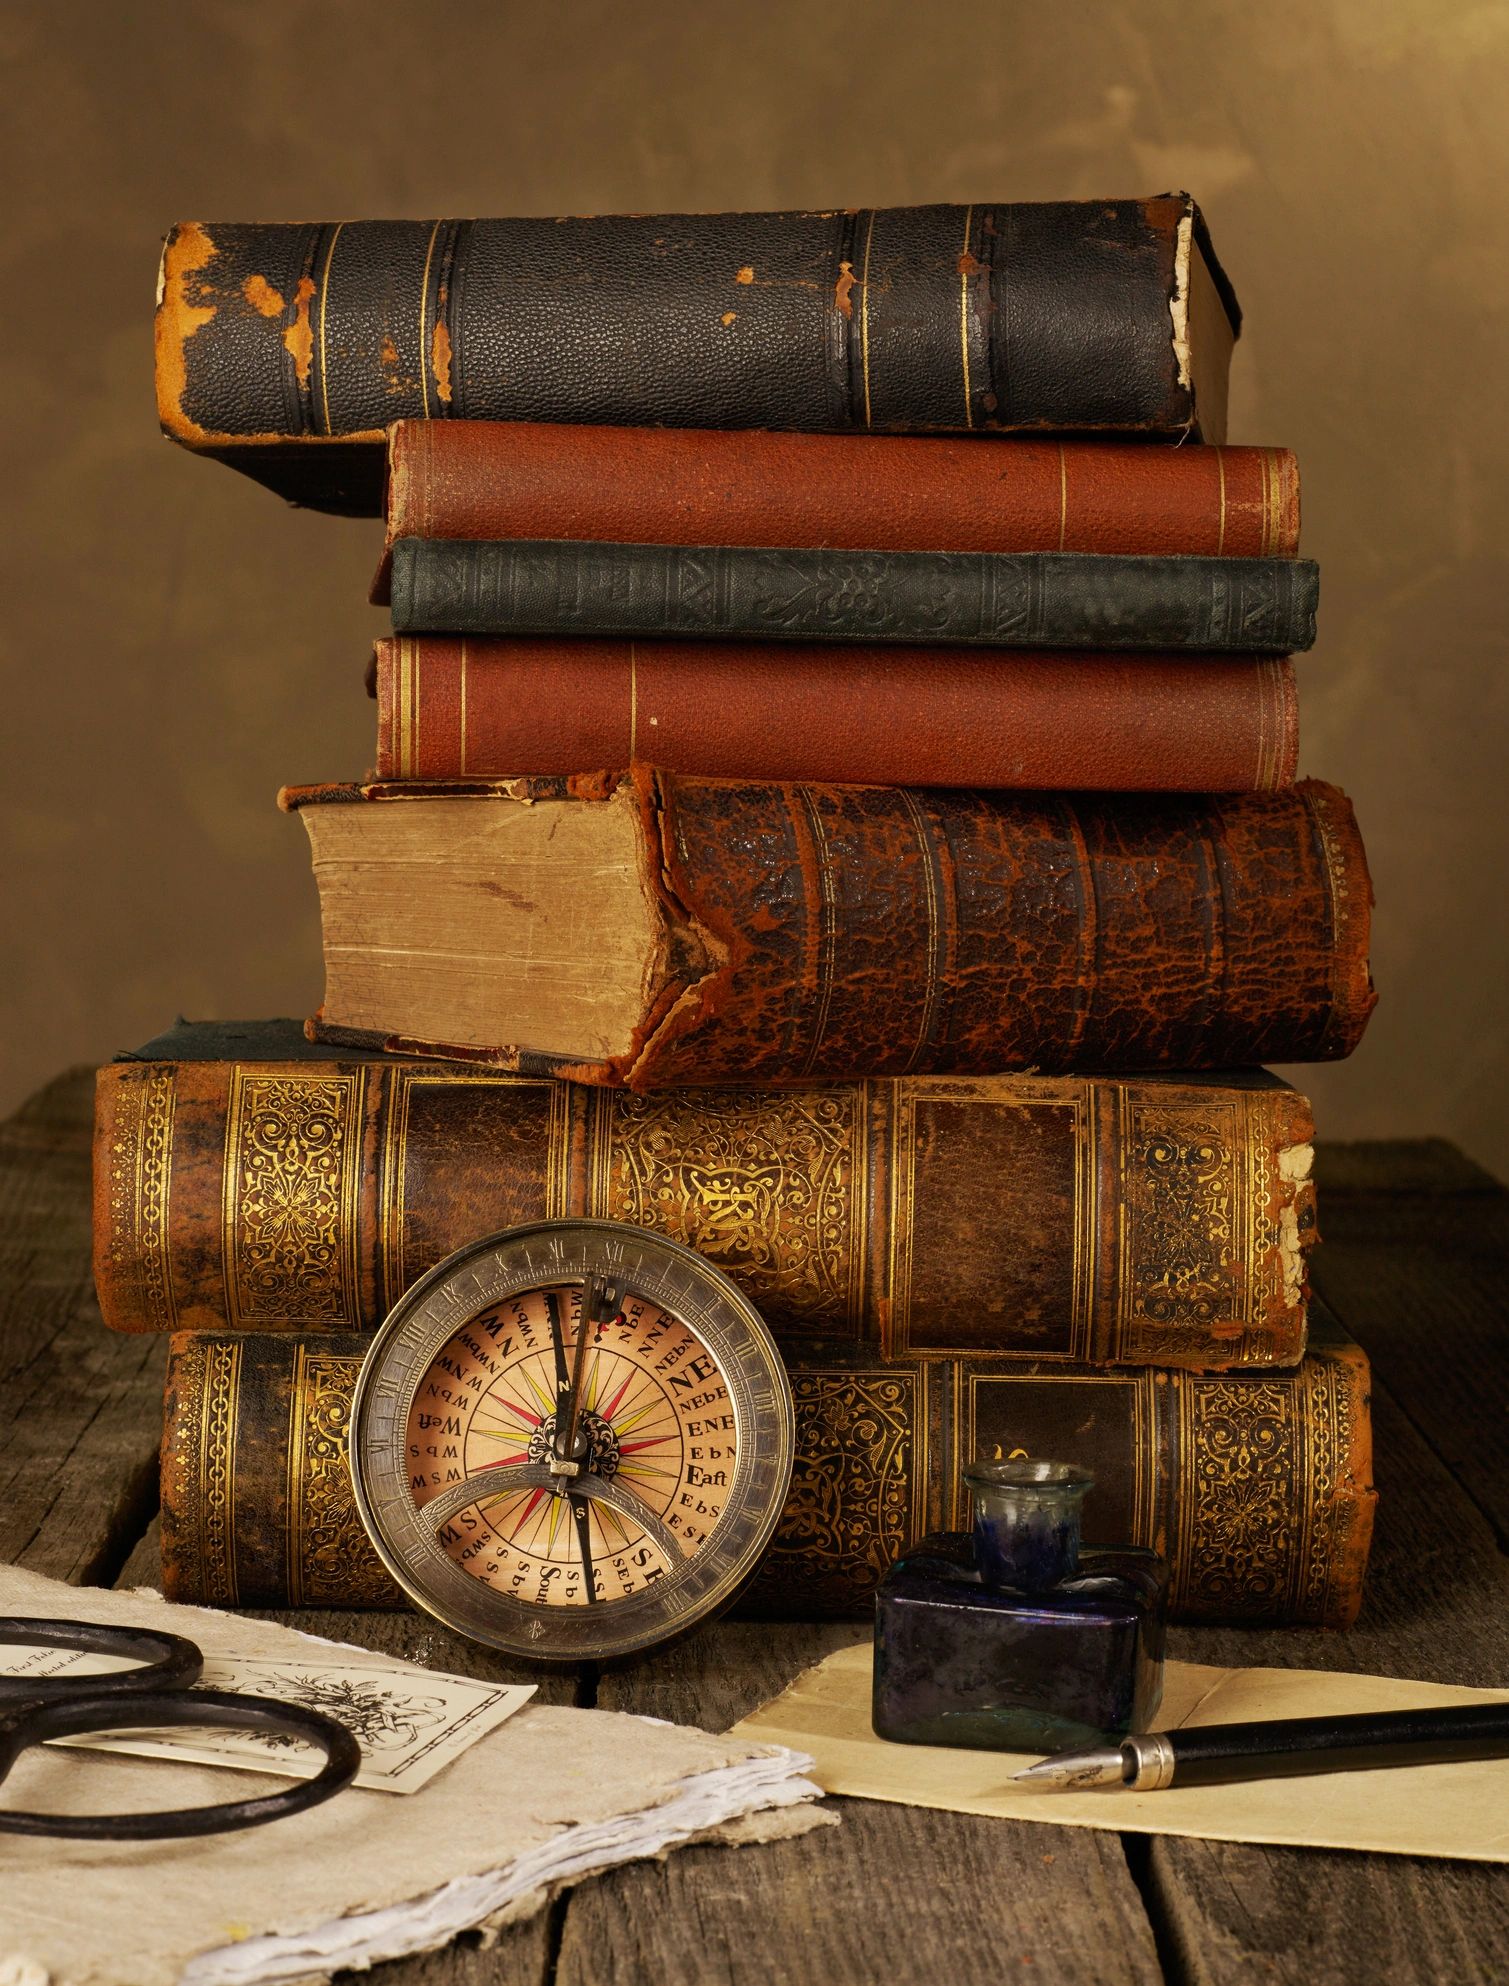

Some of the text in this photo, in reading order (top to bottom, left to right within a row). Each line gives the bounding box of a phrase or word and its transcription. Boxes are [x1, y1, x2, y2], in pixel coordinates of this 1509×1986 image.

[479, 1314, 520, 1360] NW
[510, 1302, 539, 1349] NWbN
[617, 1303, 645, 1344] NbE
[636, 1310, 676, 1360] NNE
[435, 1355, 484, 1393] WNW
[653, 1333, 696, 1377] NEbN
[558, 1380, 570, 1393] N
[665, 1353, 719, 1399] NE
[425, 1383, 469, 1411] WbN
[678, 1385, 729, 1416] NEbE
[684, 1413, 736, 1438] ENE
[575, 1507, 586, 1519] S
[534, 1565, 562, 1605] Sout
[564, 1570, 580, 1606] Sb
[612, 1557, 636, 1594] SEb
